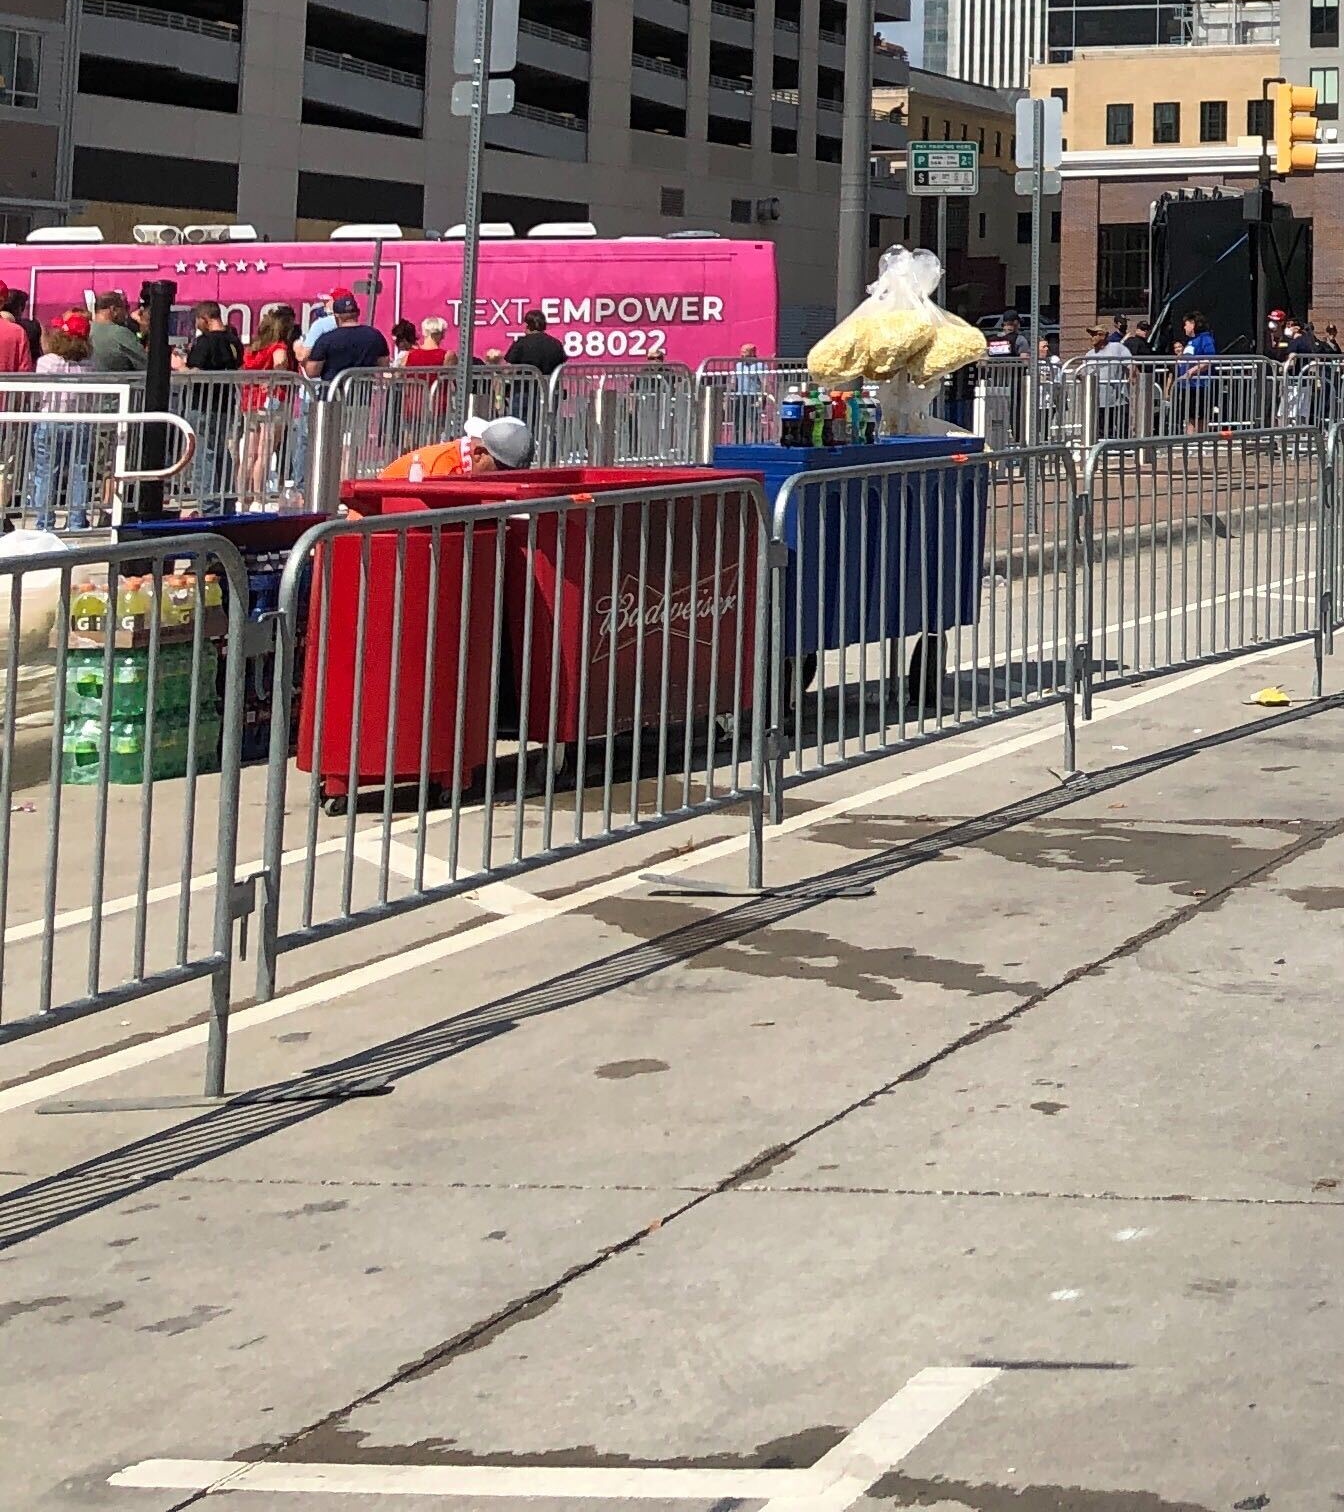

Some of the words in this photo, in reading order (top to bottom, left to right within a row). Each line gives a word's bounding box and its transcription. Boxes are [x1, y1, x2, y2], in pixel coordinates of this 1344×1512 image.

[917, 155, 926, 166] P
[446, 297, 530, 326] TEXT
[540, 295, 724, 324] EMPOWER
[563, 329, 667, 358] 88022
[77, 616, 89, 631] G
[121, 615, 135, 632] G
